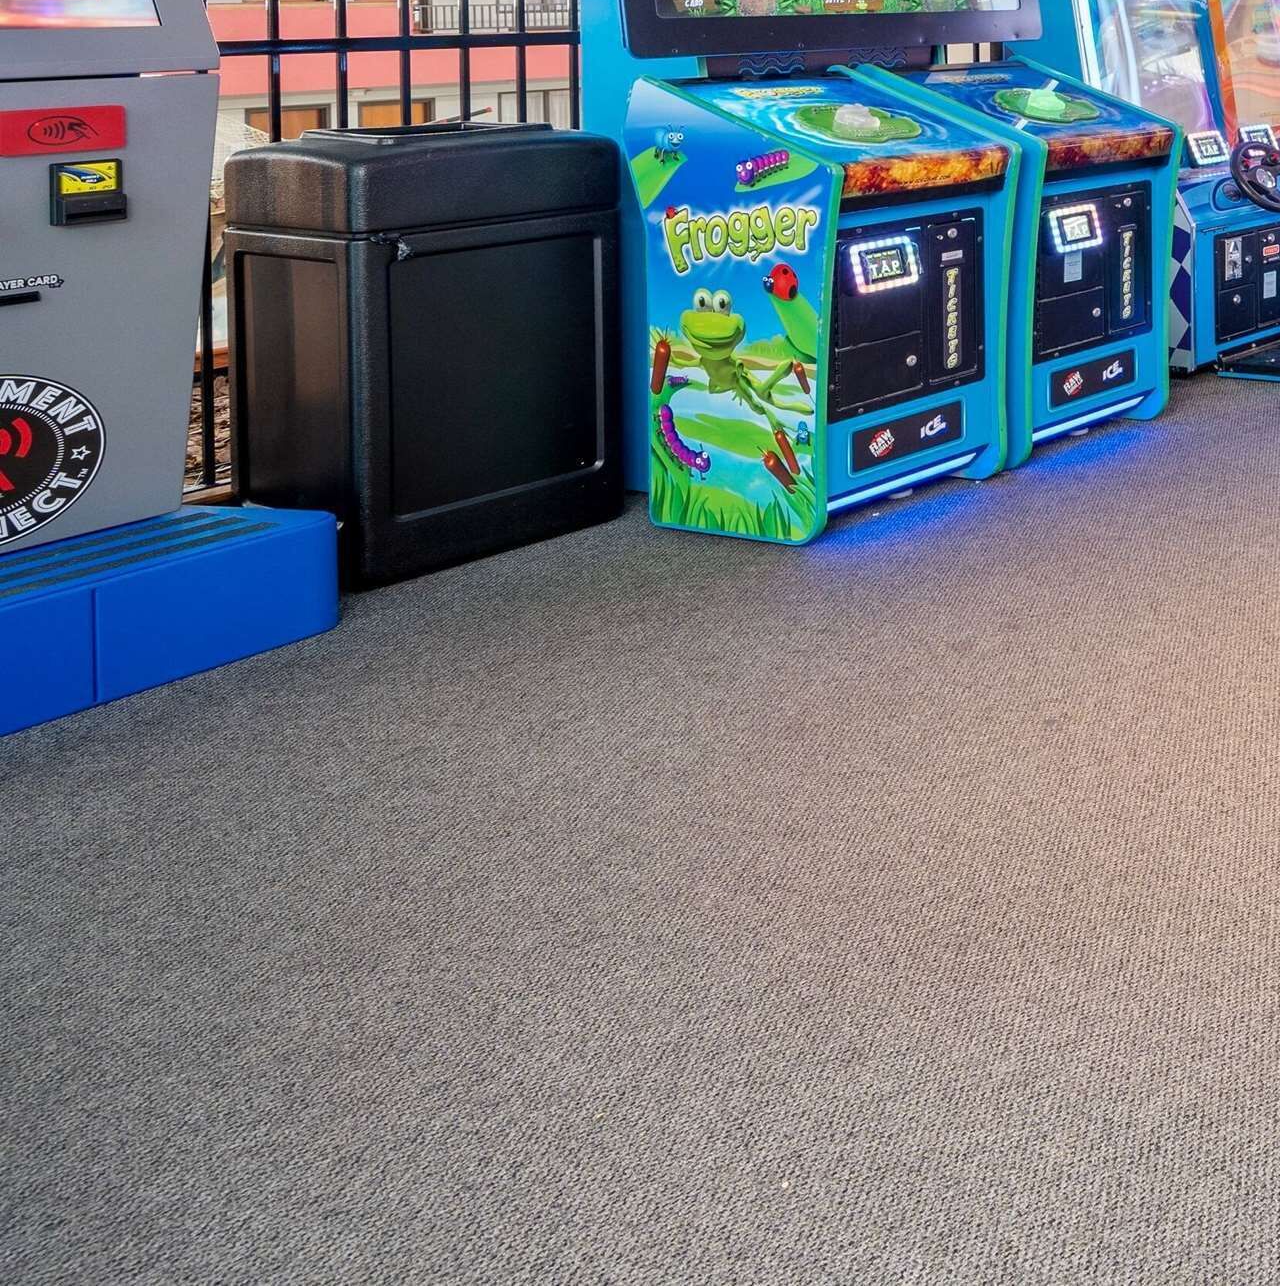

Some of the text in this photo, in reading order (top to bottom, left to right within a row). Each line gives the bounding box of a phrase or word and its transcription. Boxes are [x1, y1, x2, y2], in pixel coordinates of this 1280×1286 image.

[664, 206, 818, 273] Frogger
[27, 274, 59, 287] CARD
[870, 260, 900, 278] TAP
[945, 267, 959, 370] TICKETS
[1102, 360, 1124, 382] ICE
[920, 414, 946, 439] ICE
[868, 428, 892, 454] RAW
